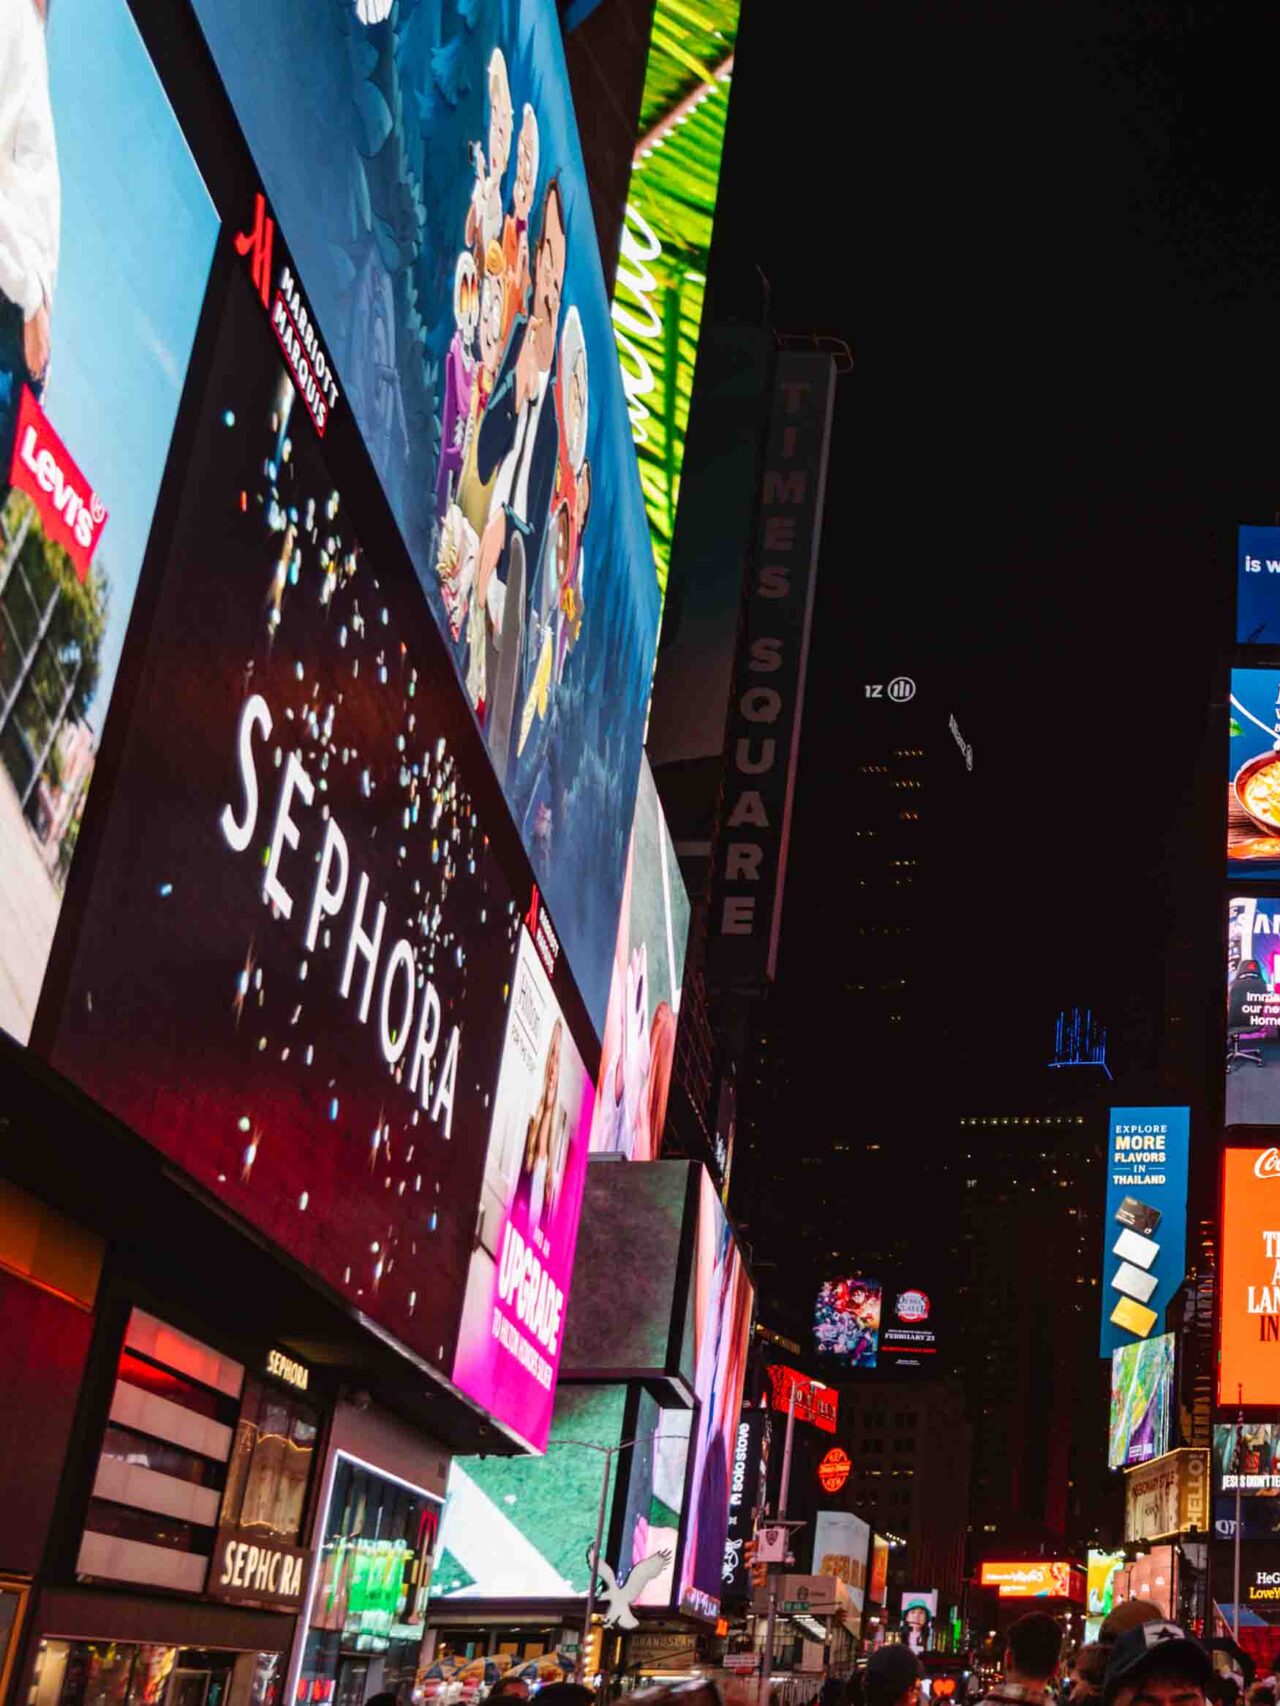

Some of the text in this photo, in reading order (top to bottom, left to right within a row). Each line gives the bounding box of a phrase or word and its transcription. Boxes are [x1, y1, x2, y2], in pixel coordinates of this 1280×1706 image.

[280, 266, 339, 408] MARRIOTT
[273, 300, 326, 427] MARQUIS
[1245, 555, 1262, 573] is
[721, 382, 811, 936] TIMES SQUARE
[220, 694, 461, 1140] SEPHORA
[1241, 1004, 1261, 1014] our
[1115, 1124, 1168, 1134] EXPLORE
[1115, 1135, 1166, 1150] MORE
[1114, 1152, 1166, 1163] FLAVORS
[1133, 1165, 1146, 1173] IN
[1113, 1175, 1167, 1185] THAILAND
[499, 1219, 564, 1356] UPGRADE
[1260, 1315, 1279, 1342] IN
[267, 1350, 310, 1391] SEPHORA
[220, 1540, 304, 1597] SEPHORA
